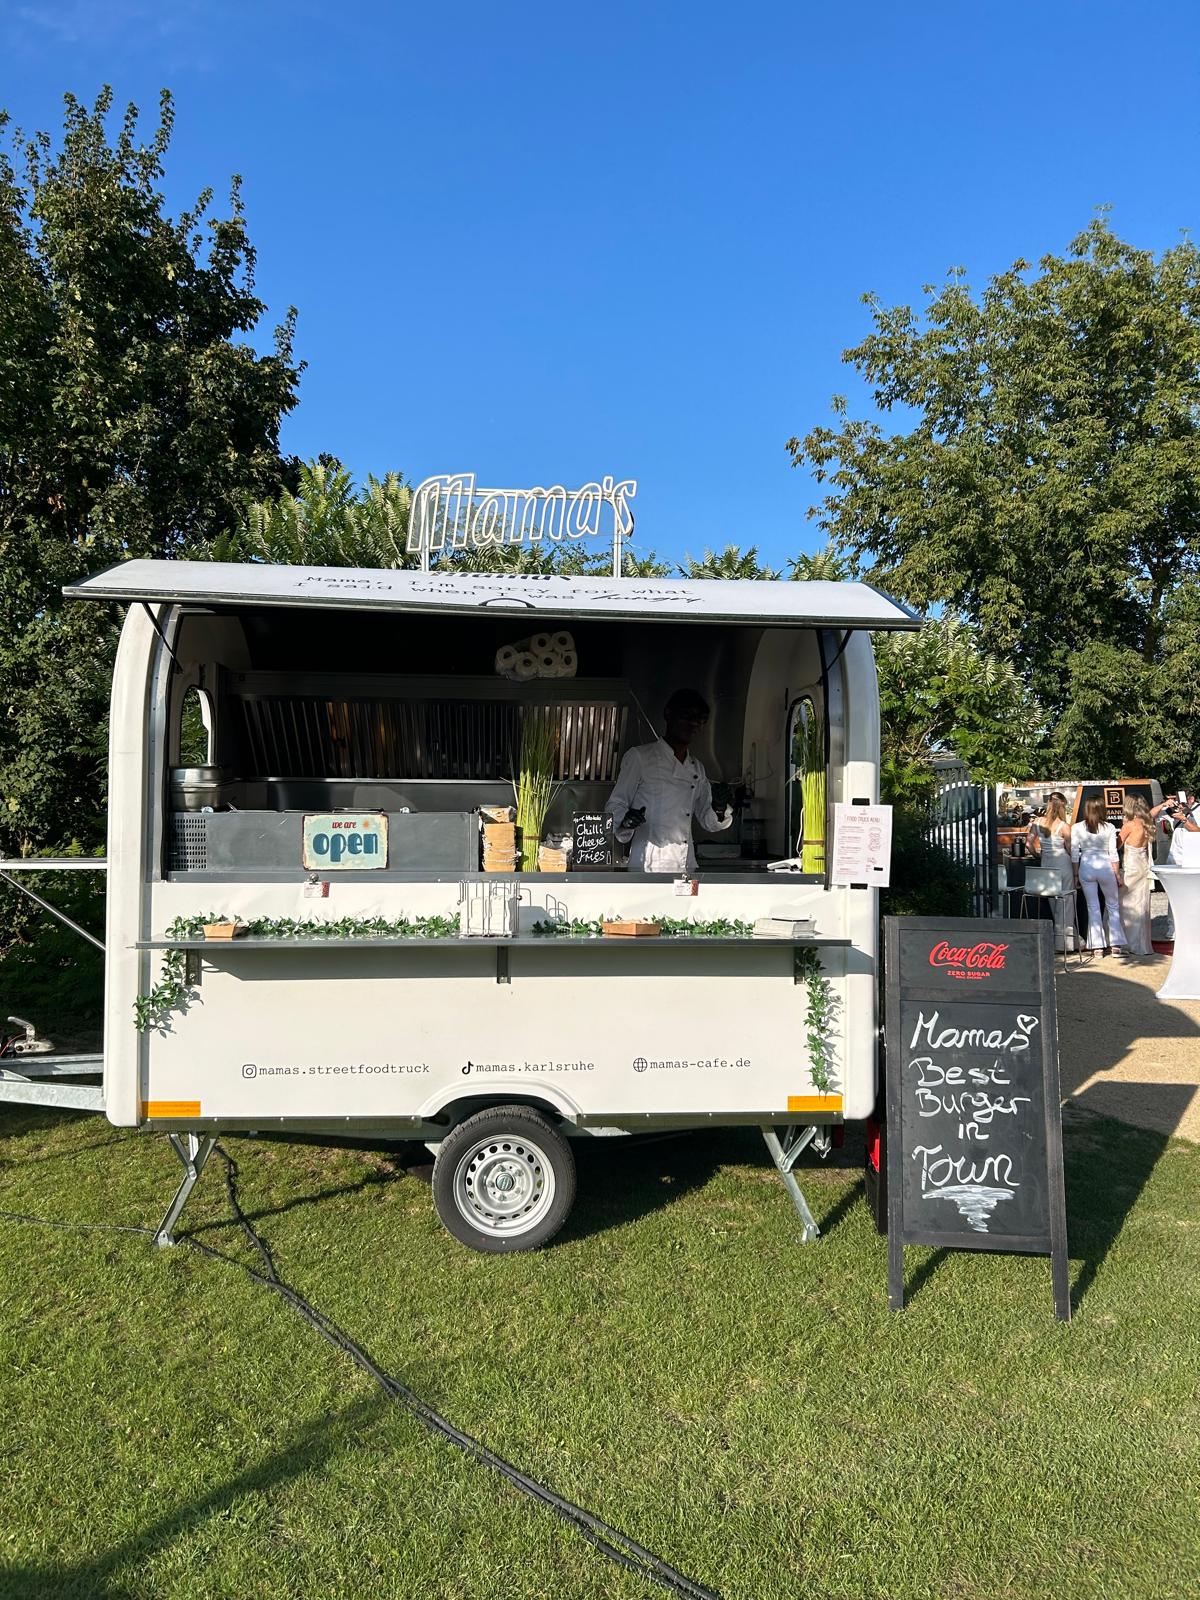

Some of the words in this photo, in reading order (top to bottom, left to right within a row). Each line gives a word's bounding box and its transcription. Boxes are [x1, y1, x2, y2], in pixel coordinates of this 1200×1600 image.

[407, 473, 637, 551] Mama's
[411, 587, 476, 595] when
[473, 585, 550, 594] sorry
[332, 821, 343, 829] we
[344, 821, 357, 829] are
[576, 823, 604, 836] Chilli
[313, 833, 378, 862] open
[576, 836, 607, 850] Cheese
[576, 849, 605, 864] Fries
[929, 941, 1009, 968] Coca-Cola
[258, 1063, 430, 1076] mamas.streetfoodtruck
[475, 1061, 595, 1072] mamas.karlsruhe
[649, 1057, 751, 1070] mamas-cafe.de
[909, 1056, 1011, 1087] Best
[915, 1088, 1031, 1123] Burger
[958, 1117, 990, 1140] in
[912, 1144, 1021, 1190] Town
